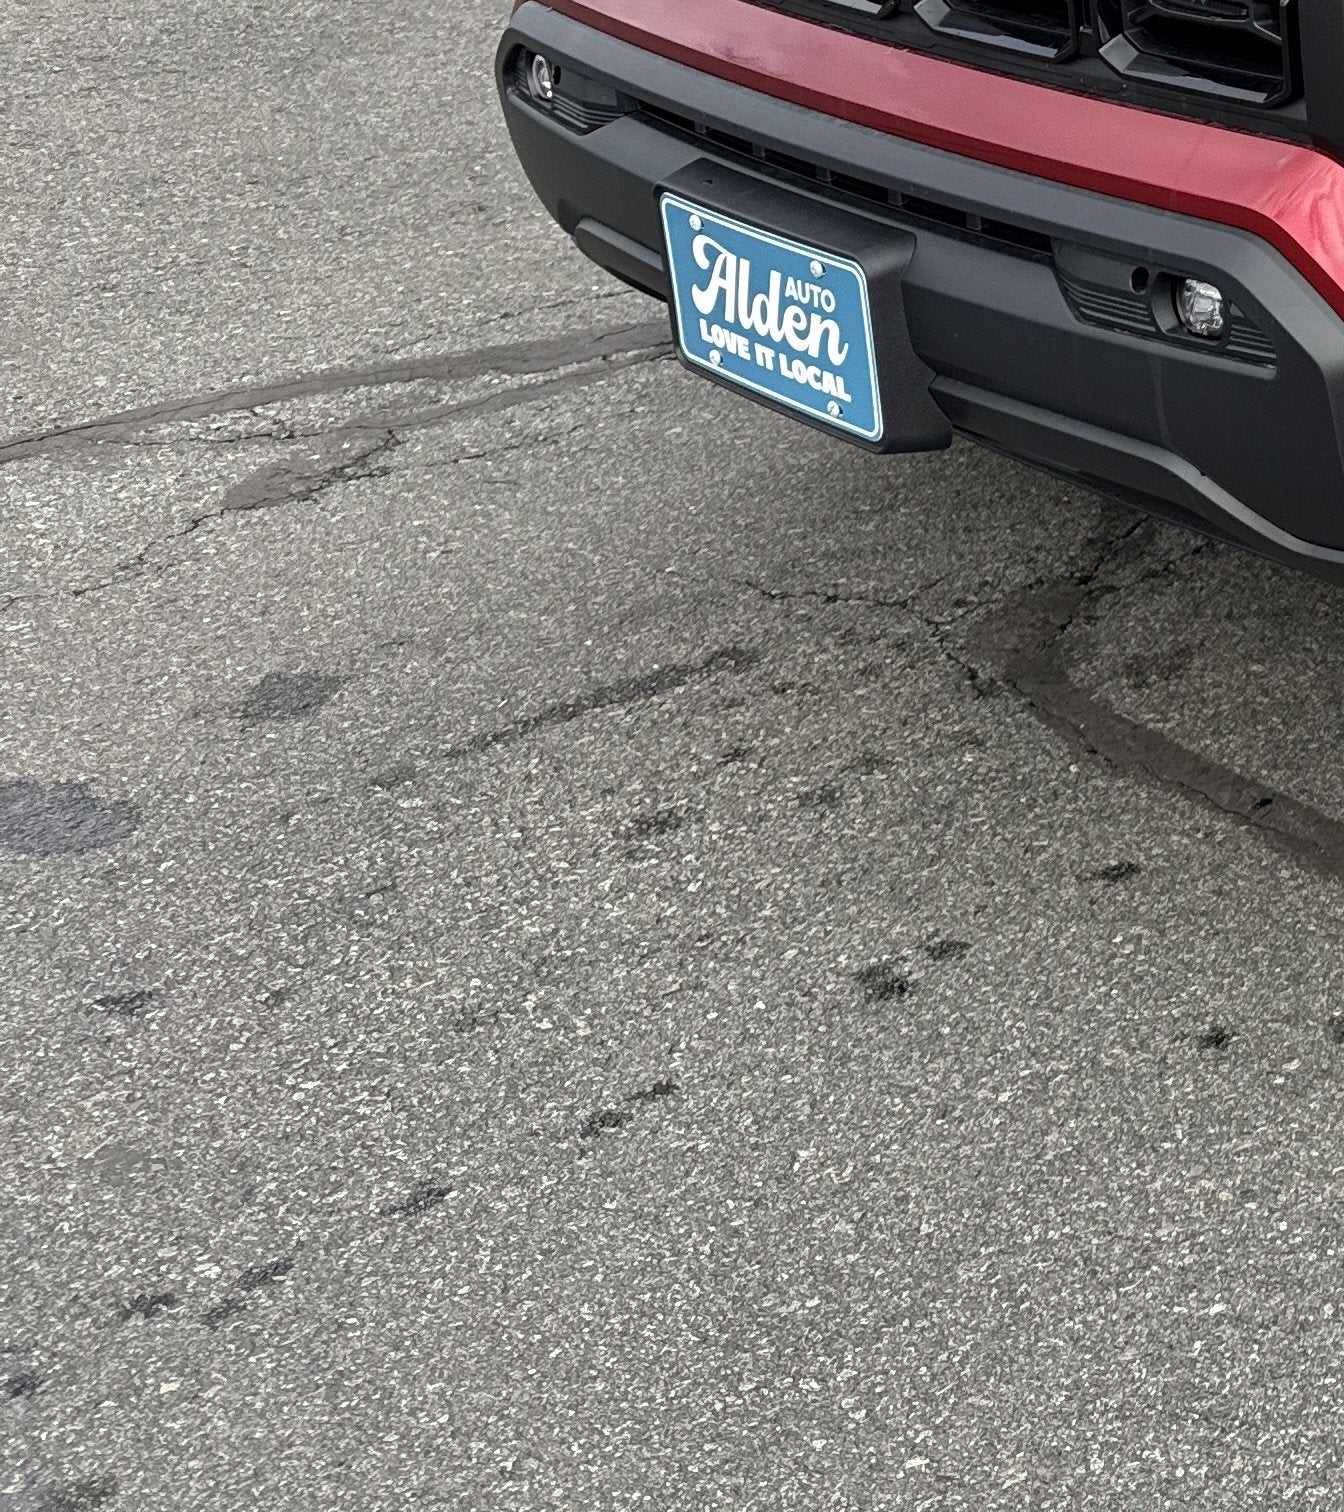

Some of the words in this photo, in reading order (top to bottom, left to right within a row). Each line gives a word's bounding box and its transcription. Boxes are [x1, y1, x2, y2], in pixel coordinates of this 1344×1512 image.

[692, 234, 849, 366] Alden
[785, 276, 836, 313] AUTO
[700, 318, 751, 361] LOVE
[754, 343, 775, 370] IT
[779, 354, 852, 402] LOCAL
